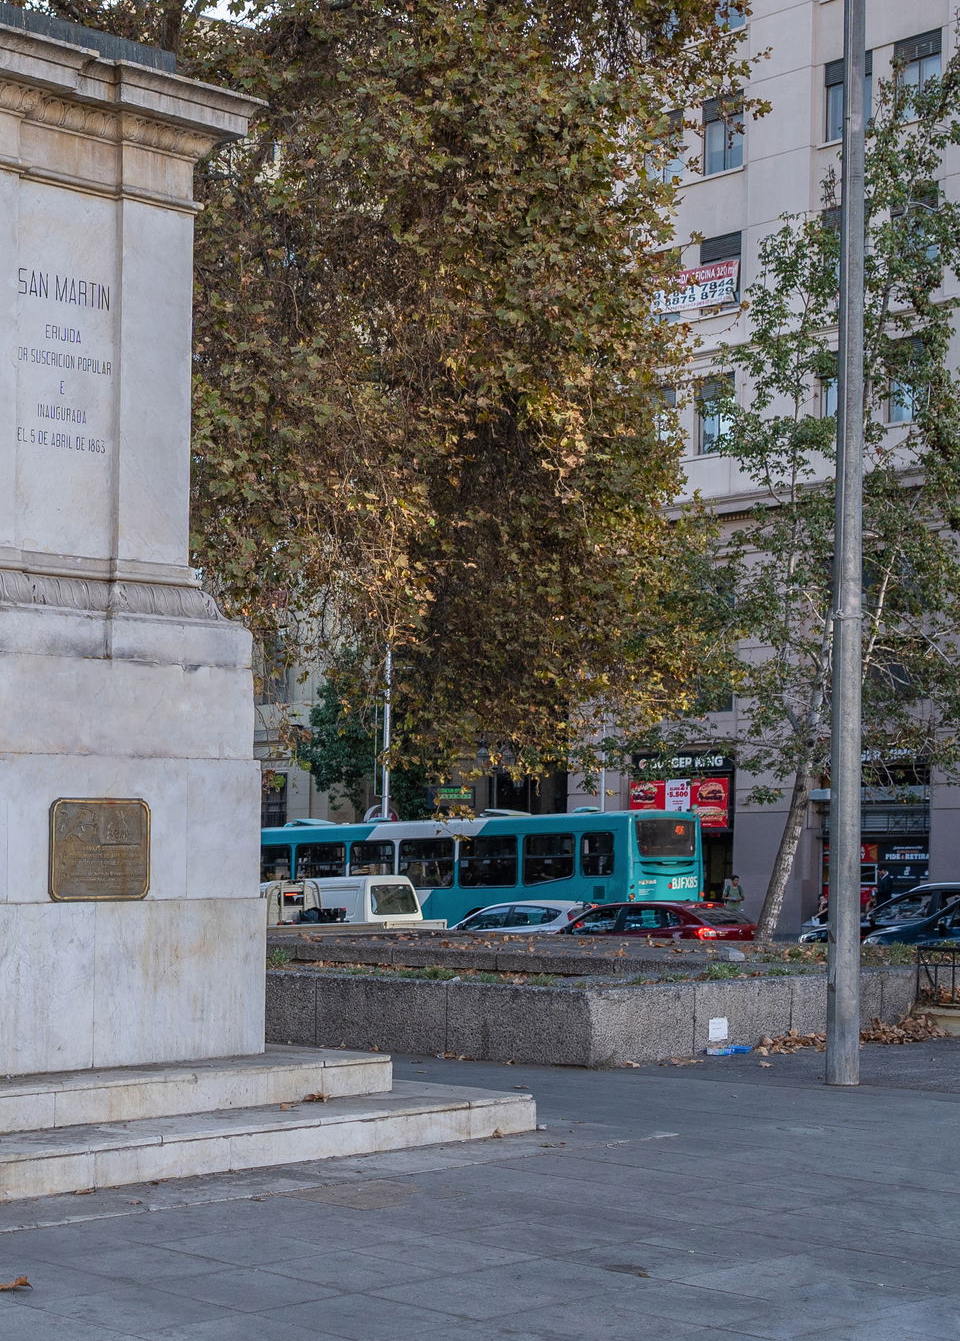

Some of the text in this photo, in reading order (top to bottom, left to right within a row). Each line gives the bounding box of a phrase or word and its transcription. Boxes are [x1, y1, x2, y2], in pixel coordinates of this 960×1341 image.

[691, 268, 716, 282] FICINA
[717, 265, 727, 277] 320
[18, 267, 110, 312] SAN MARTIN
[700, 277, 735, 292] 7844
[700, 286, 734, 301] 8729
[45, 324, 82, 344] ERIJIDA
[31, 348, 75, 370] SUSCRICION
[77, 356, 112, 376] POPULAR
[59, 380, 65, 395] E
[37, 403, 87, 425] INAUGURADA
[17, 426, 106, 454] EL 5 DE ABRIL DE 1863
[650, 757, 693, 769] BUGER
[884, 853, 901, 861] PIDE
[672, 876, 698, 890] BJFX85
